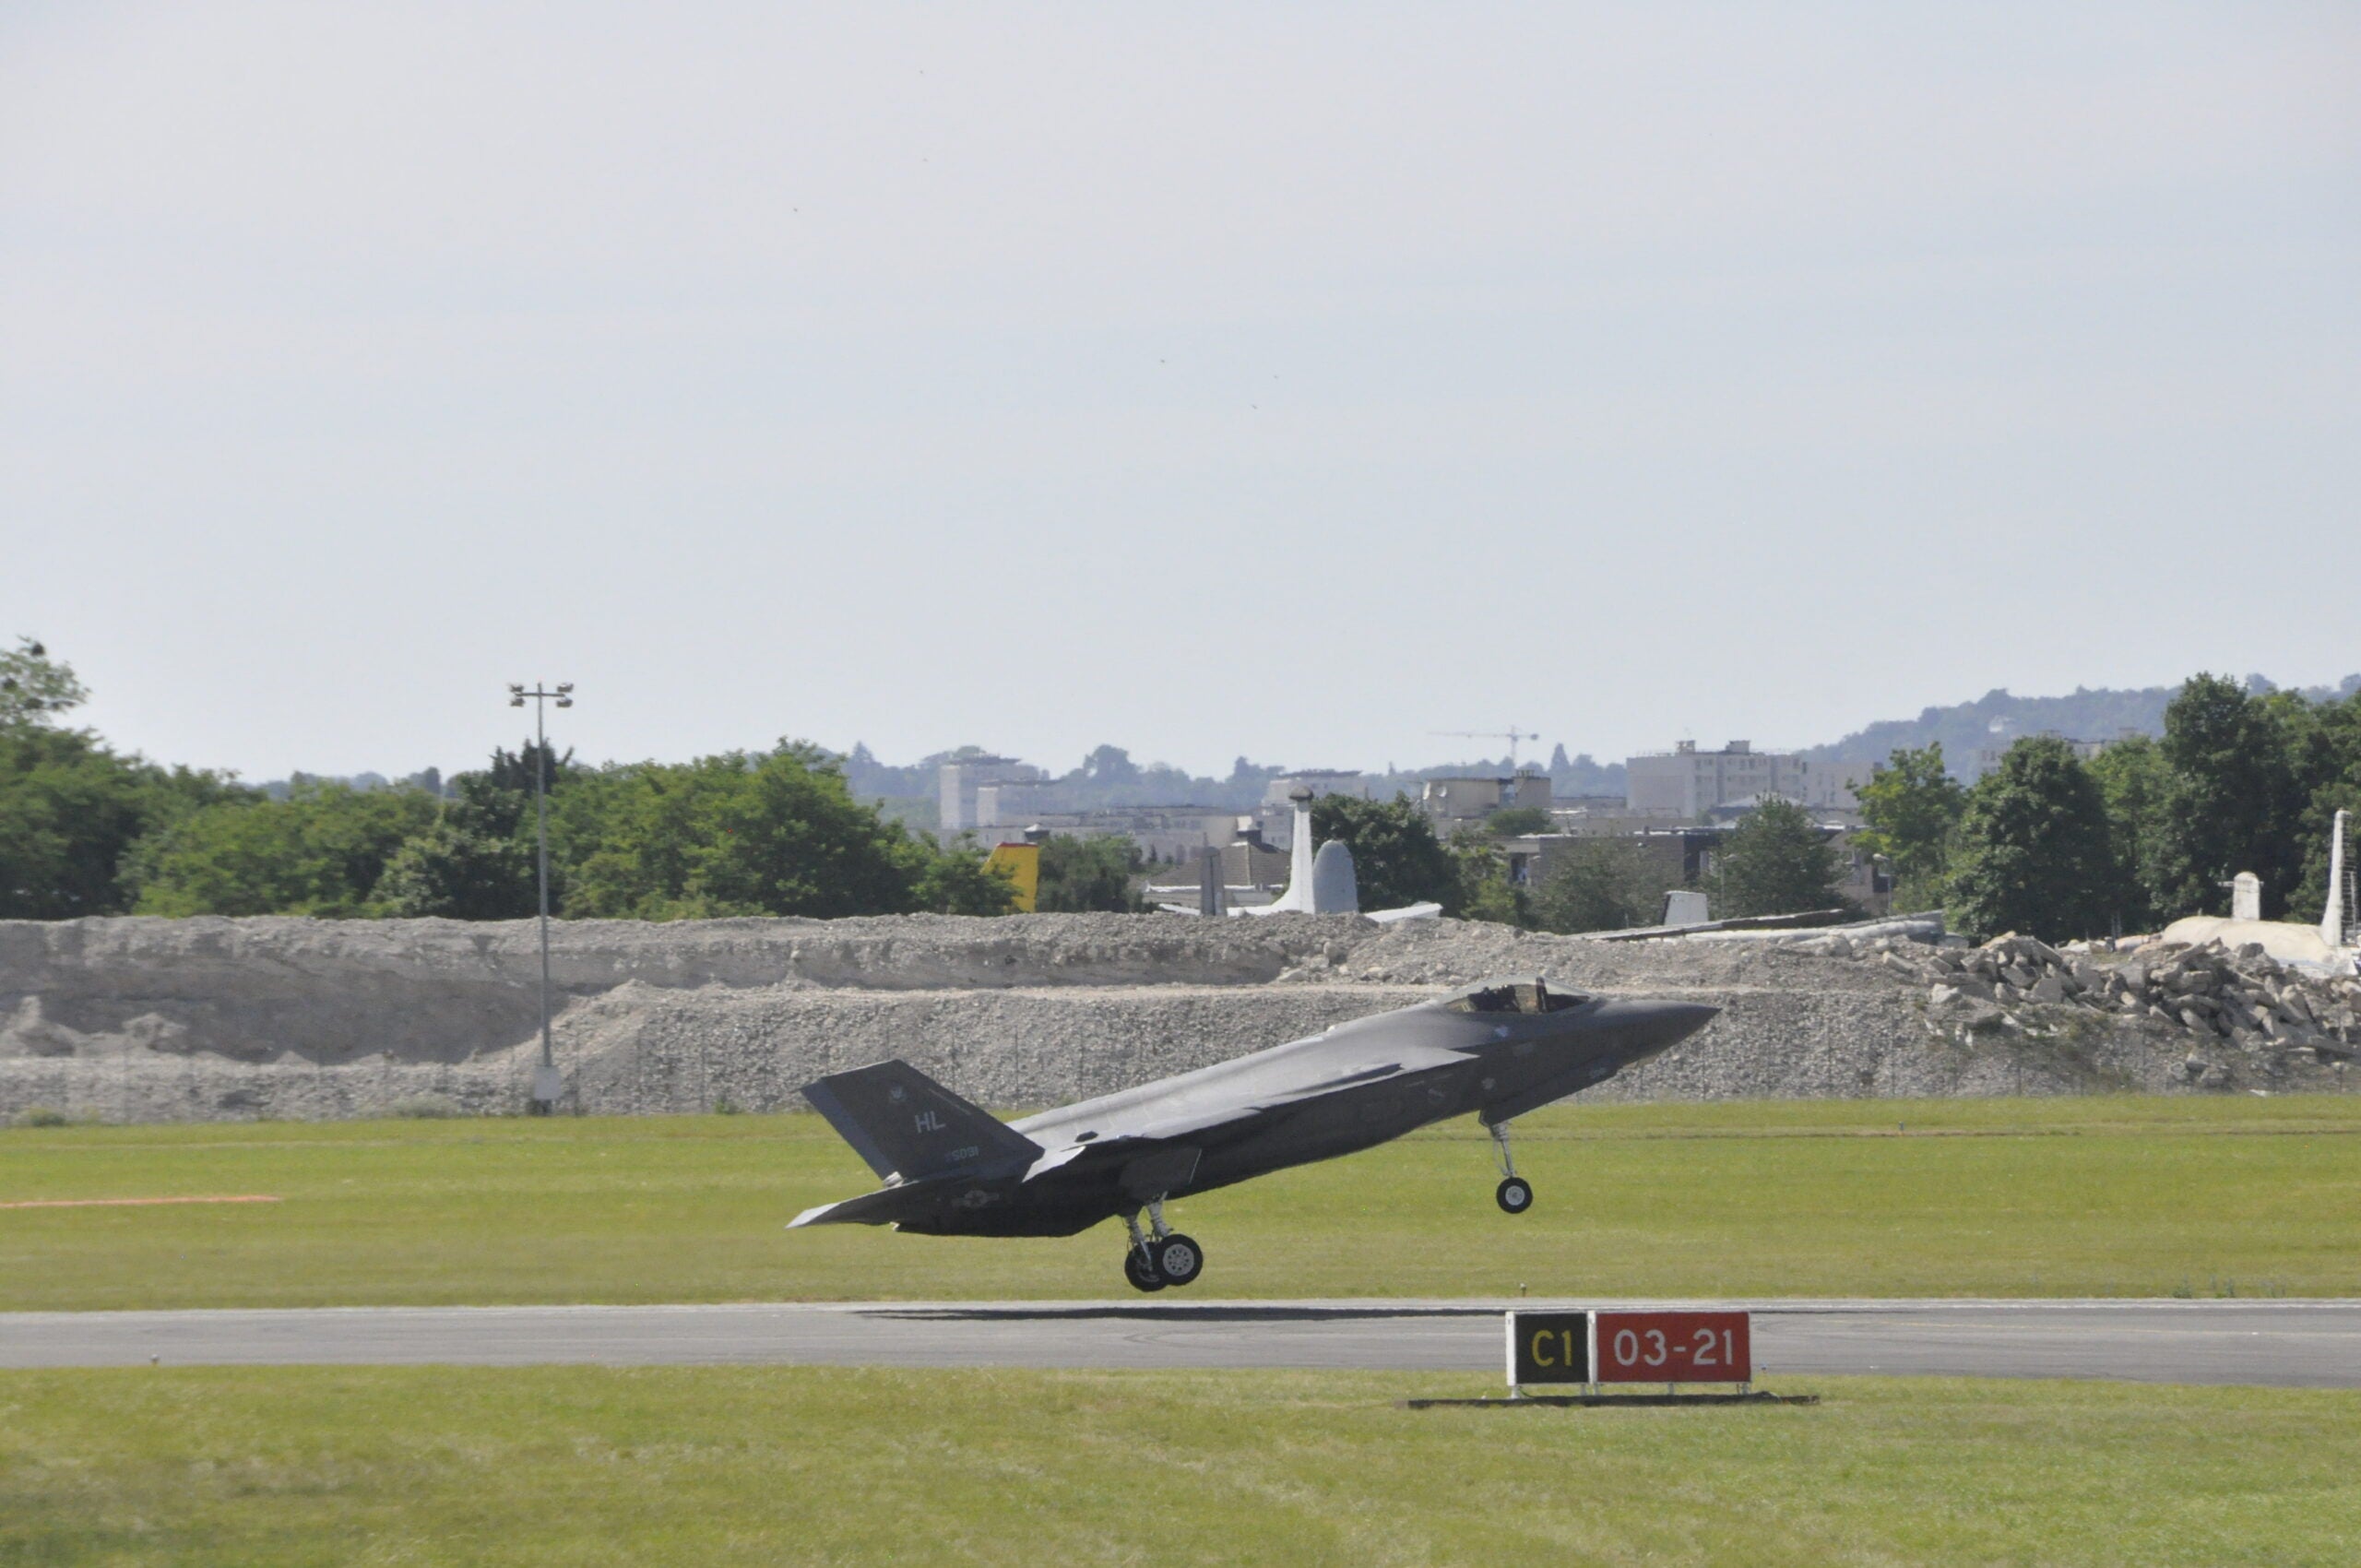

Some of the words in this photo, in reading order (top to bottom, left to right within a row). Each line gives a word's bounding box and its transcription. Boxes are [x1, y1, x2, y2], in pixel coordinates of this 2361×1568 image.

[915, 1110, 946, 1134] HL
[1531, 1329, 1572, 1367] C1
[1614, 1328, 1733, 1366] 03-21
